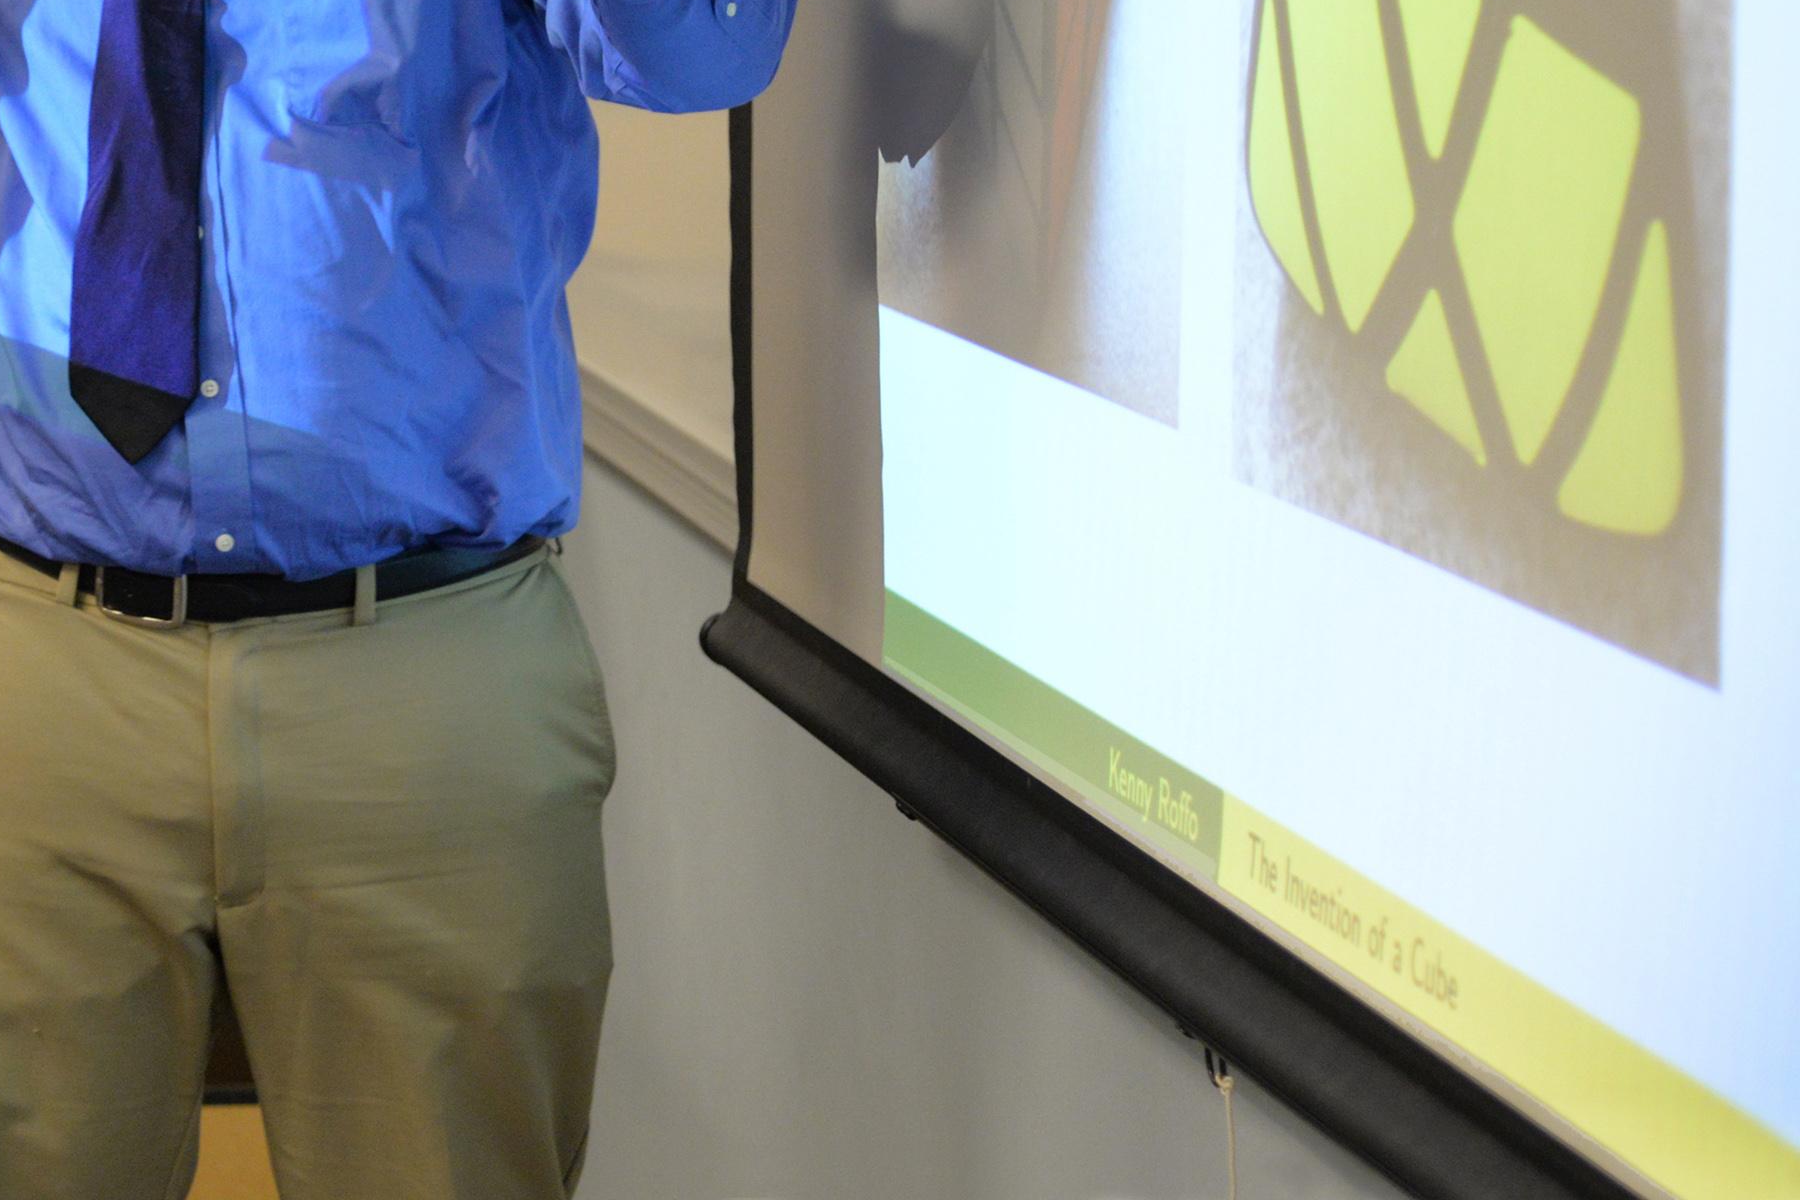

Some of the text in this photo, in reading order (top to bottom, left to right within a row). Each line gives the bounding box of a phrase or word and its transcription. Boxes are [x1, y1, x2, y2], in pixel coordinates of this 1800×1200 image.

[1108, 747, 1199, 841] Kenny Roffo
[1247, 830, 1459, 1010] The Invention of a Cube
